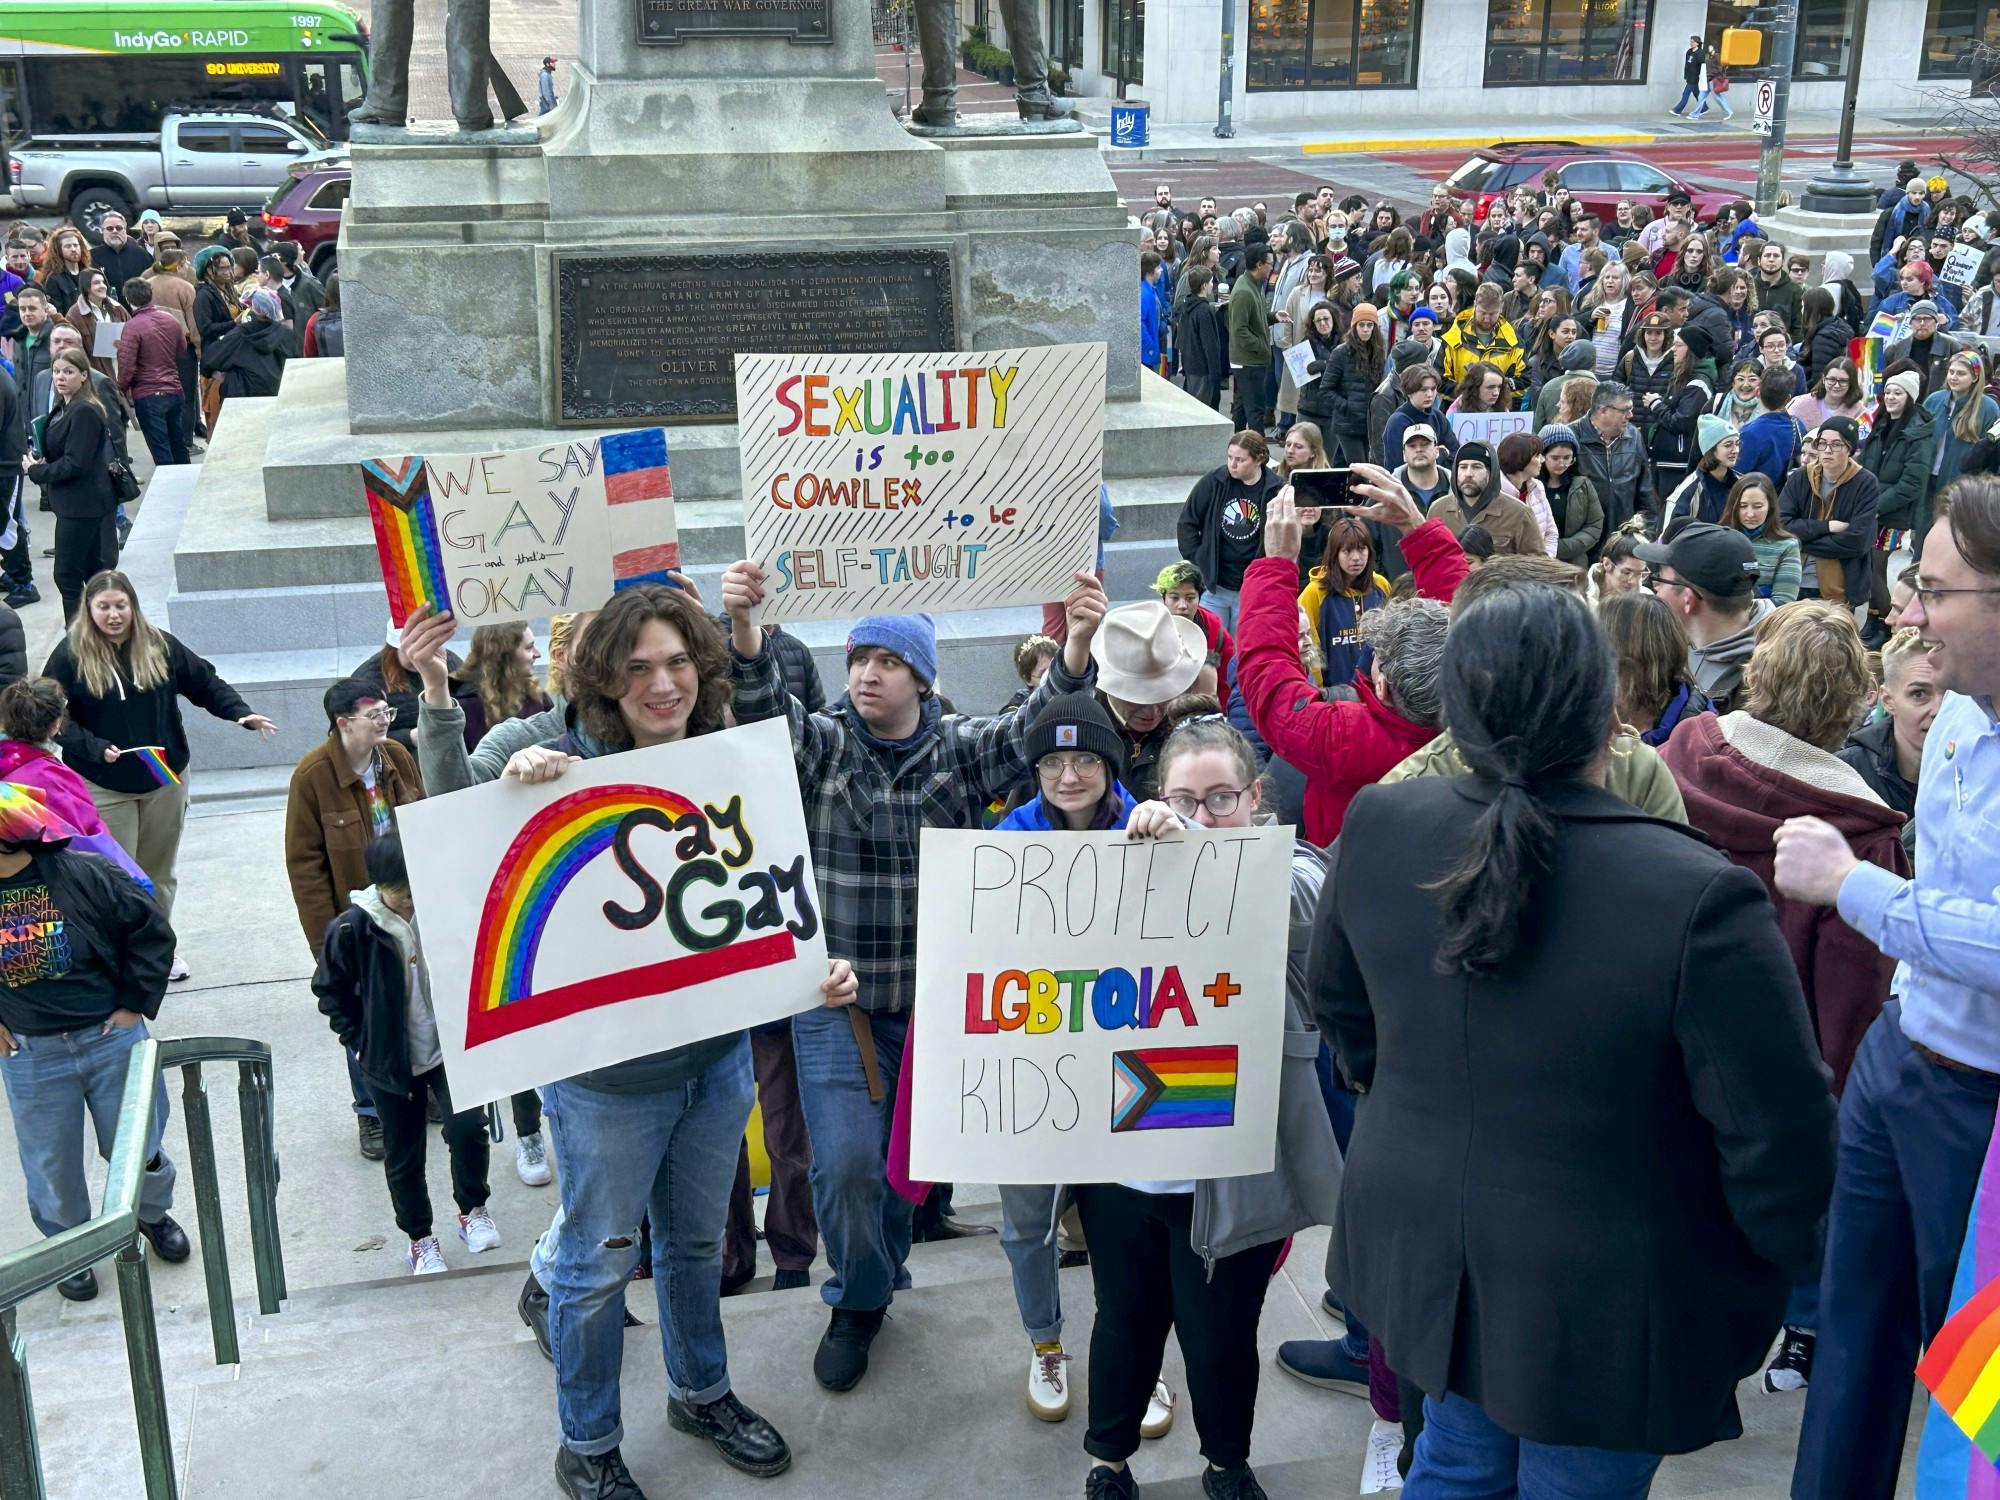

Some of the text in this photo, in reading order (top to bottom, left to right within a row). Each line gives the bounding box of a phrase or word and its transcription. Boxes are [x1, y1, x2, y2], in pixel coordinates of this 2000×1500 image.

[648, 0, 674, 11] THE
[679, 0, 718, 11] GREAT
[723, 0, 751, 10] WAR
[291, 16, 321, 27] 1997
[115, 31, 248, 50] IndyGo RAPID
[206, 63, 280, 75] 90 UNIVERSITY
[791, 278, 805, 286] THE
[809, 277, 864, 286] DEPARTMENT
[879, 275, 913, 284] INDIANA
[662, 292, 701, 301] GRAND
[708, 290, 739, 300] ARMY
[748, 290, 760, 299] OF
[767, 289, 791, 299] THE
[609, 304, 671, 313] ORGANIZATION
[675, 304, 684, 312] OF
[690, 303, 705, 312] THE
[710, 302, 760, 311] HONORABLY
[767, 300, 818, 309] DISCHARGED
[650, 316, 664, 324] THE
[667, 315, 689, 324] ARMY
[691, 314, 707, 323] AND
[800, 310, 836, 319] INTEGRITY
[838, 310, 847, 318] OF
[849, 309, 862, 317] THE
[708, 325, 721, 334] THE
[726, 323, 757, 333] GREAT
[761, 322, 788, 332] CIVIL
[790, 321, 811, 331] WAR
[590, 338, 648, 347] MEMORIALIZED
[650, 337, 665, 346] THE
[667, 336, 719, 346] LEGISLATURE
[750, 334, 773, 343] STATE
[777, 333, 786, 342] OF
[788, 332, 819, 342] INDIANA
[822, 332, 832, 341] TO
[834, 331, 884, 340] APPROPRIATE
[617, 349, 644, 358] MONEY
[650, 349, 661, 357] TO
[837, 343, 852, 352] THE
[855, 342, 888, 351] MEMORY
[661, 359, 718, 373] OLIVER
[628, 378, 643, 387] THE
[647, 377, 673, 387] GREAT
[775, 365, 1018, 437] SEXUALITY
[856, 444, 955, 472] is too
[425, 439, 600, 499] WE SAY
[771, 473, 923, 510] COMPLEX
[442, 486, 581, 553] GAY
[943, 505, 1017, 529] to be
[484, 552, 546, 569] and that's
[775, 543, 988, 594] SELF-TAUGHT
[456, 566, 575, 619] OKAY
[1339, 627, 1358, 637] INDI
[603, 795, 755, 931] Say
[970, 838, 1261, 940] PROTECT
[665, 855, 819, 953] Gay
[0, 921, 65, 945] KIND
[960, 1054, 1081, 1135] KIDS
